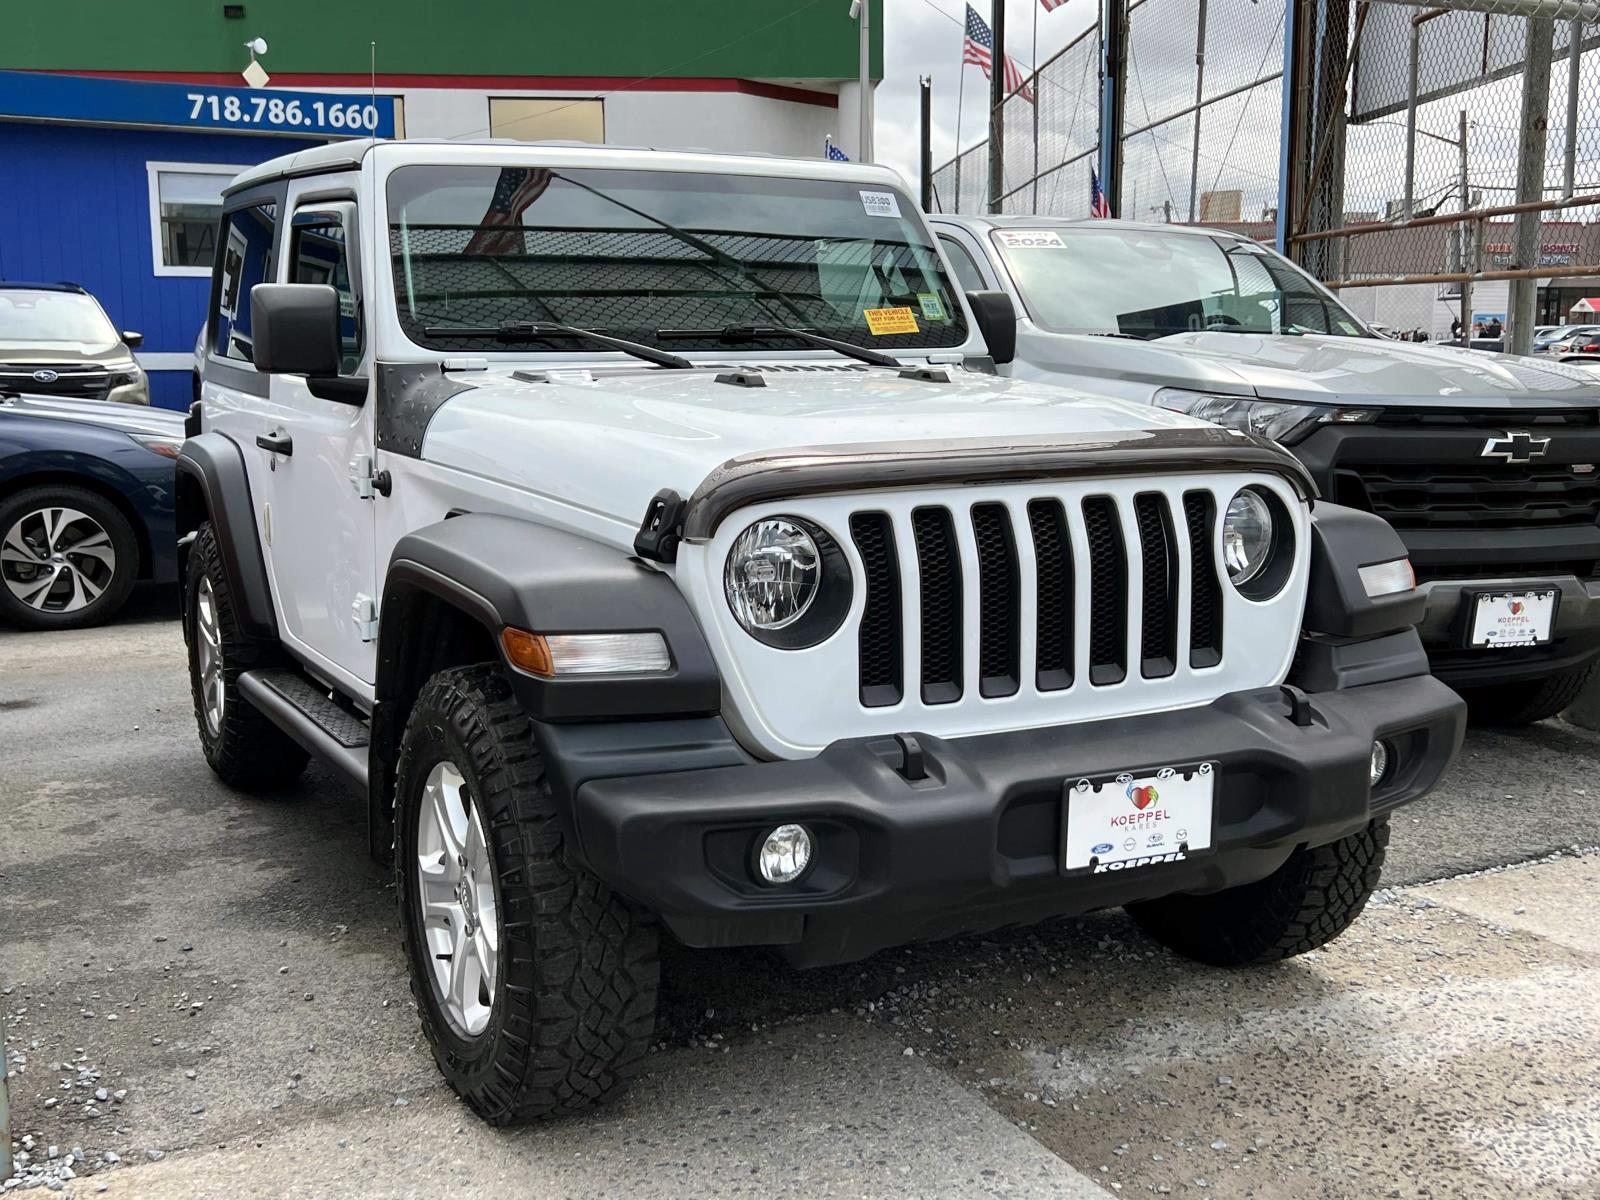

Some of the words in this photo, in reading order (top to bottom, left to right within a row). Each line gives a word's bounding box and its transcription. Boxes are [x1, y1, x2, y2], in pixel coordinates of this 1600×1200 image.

[187, 93, 379, 129] 718.786.1660
[1007, 238, 1062, 246] 2024
[1487, 640, 1536, 648] KOEPPEL
[1110, 810, 1171, 827] KOEPPEL
[1124, 822, 1158, 832] KARES
[1094, 852, 1186, 873] KOEPPEL
